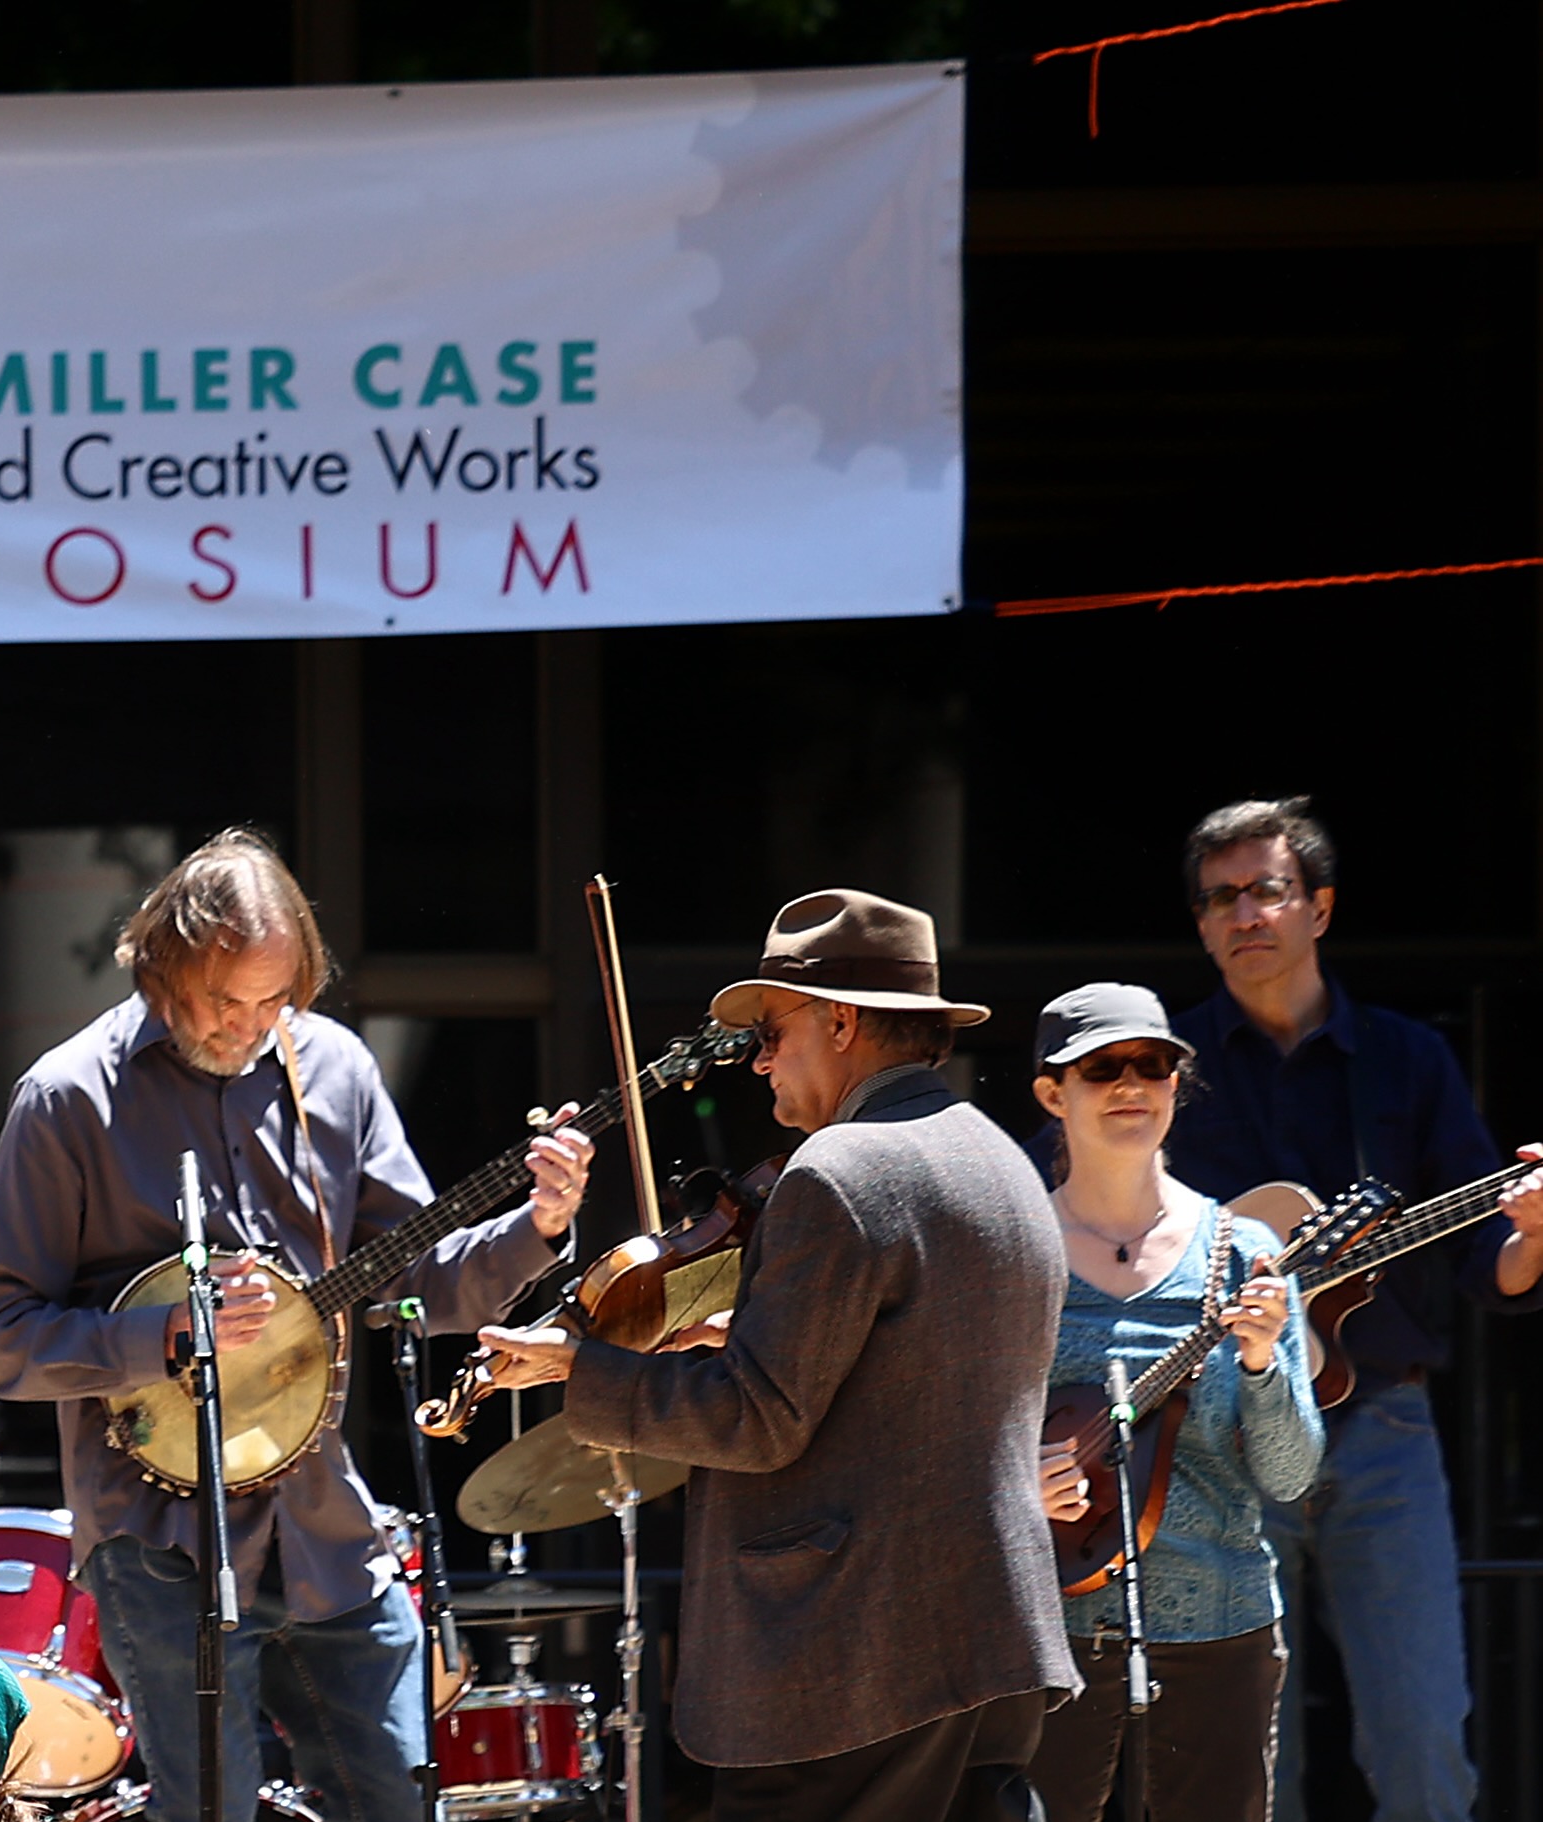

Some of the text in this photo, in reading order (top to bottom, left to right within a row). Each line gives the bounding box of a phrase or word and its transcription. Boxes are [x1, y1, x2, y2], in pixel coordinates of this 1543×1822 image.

[353, 341, 598, 409] CASE
[62, 431, 352, 500] Creative
[374, 415, 601, 493] Works
